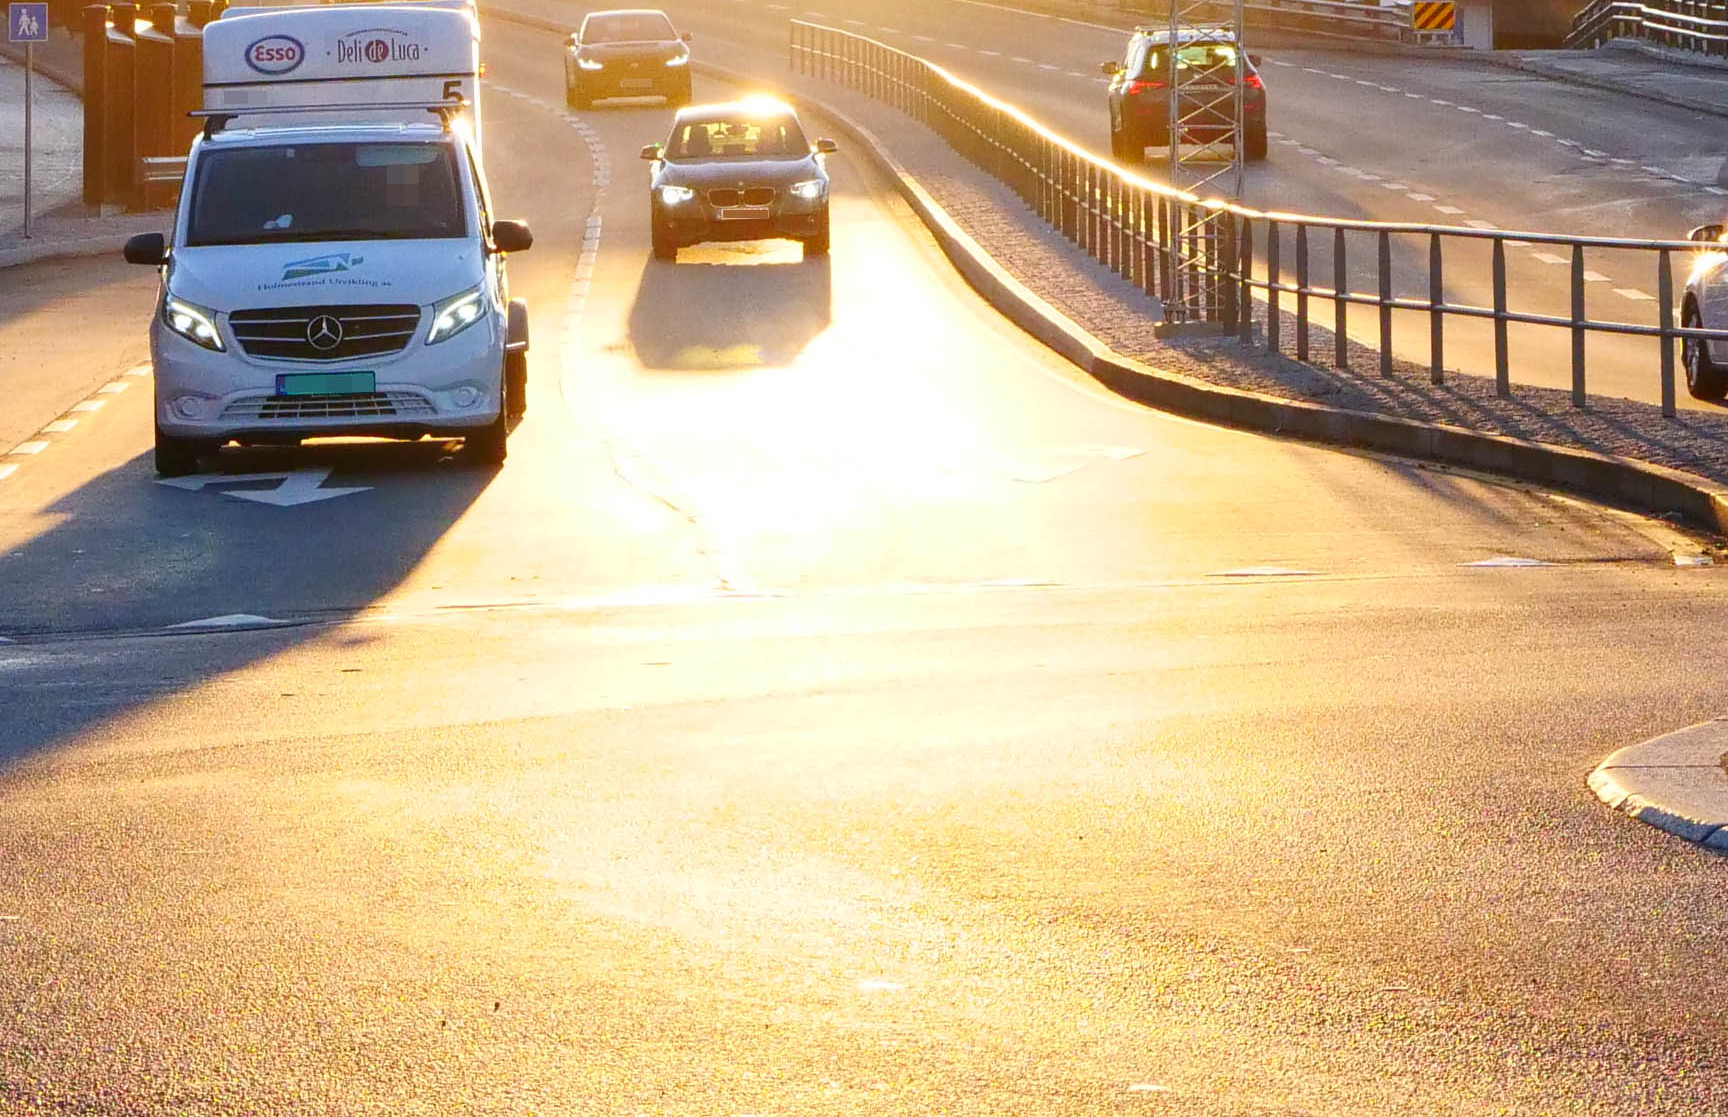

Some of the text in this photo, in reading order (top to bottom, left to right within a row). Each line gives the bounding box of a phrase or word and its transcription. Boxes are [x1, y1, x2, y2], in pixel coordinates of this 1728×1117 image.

[254, 44, 296, 62] Esso
[337, 37, 420, 64] Deli de Luca
[443, 80, 464, 104] 5
